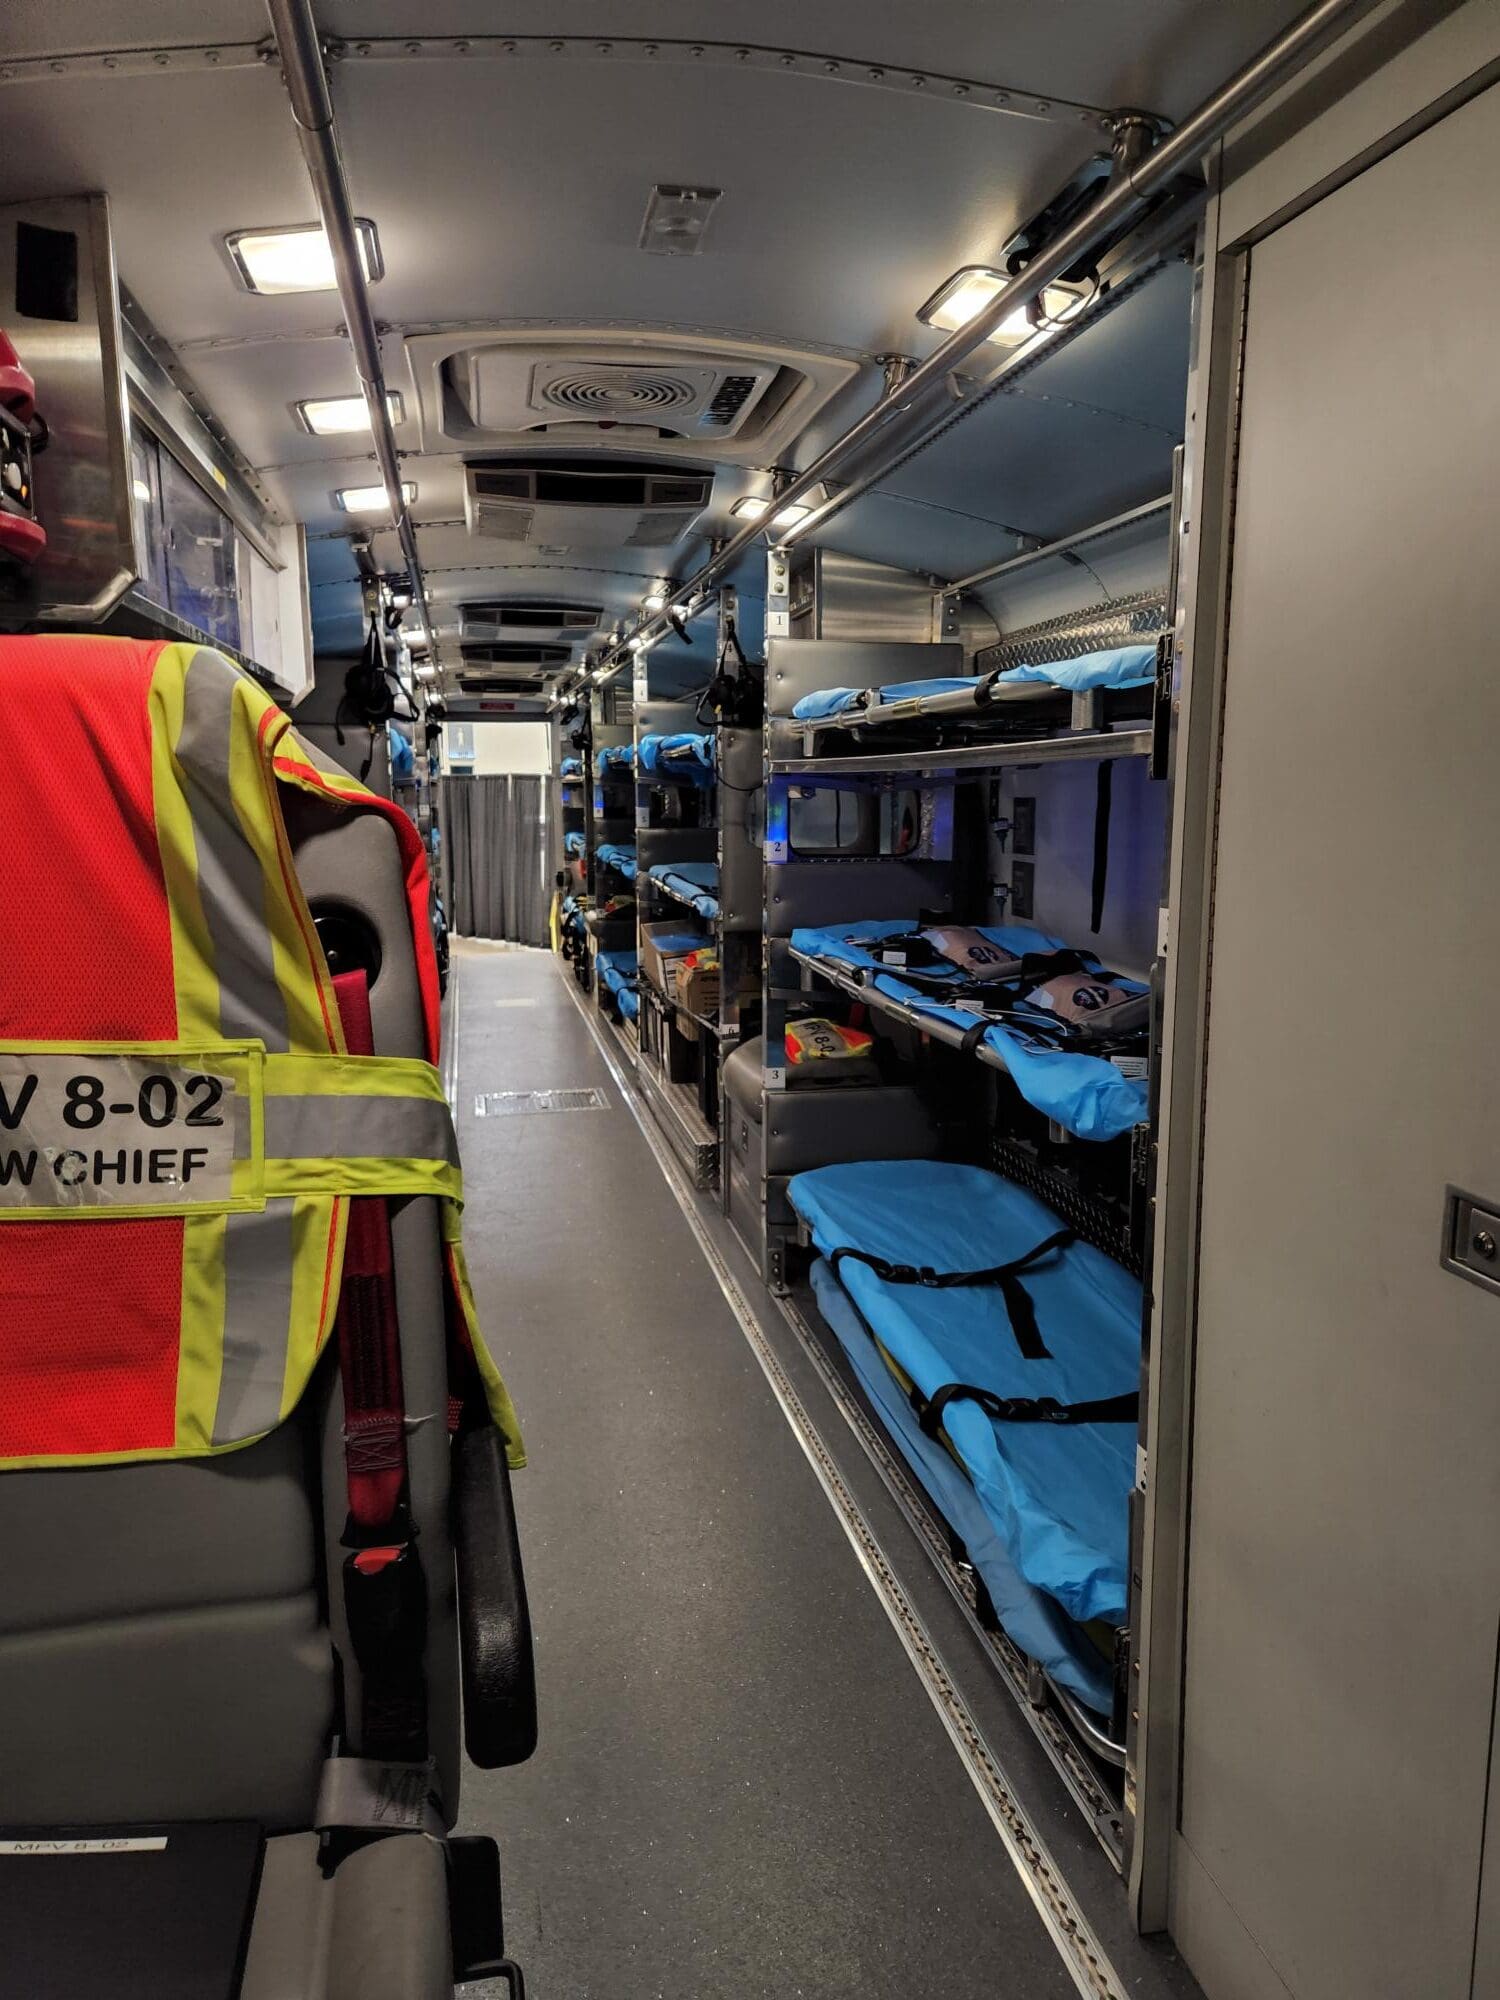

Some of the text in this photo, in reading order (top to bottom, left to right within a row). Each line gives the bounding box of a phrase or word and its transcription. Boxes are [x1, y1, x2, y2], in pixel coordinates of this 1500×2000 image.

[778, 616, 783, 625] 1
[774, 841, 781, 852] 2
[814, 1035, 836, 1057] 8-0
[772, 1069, 779, 1080] 3
[0, 1074, 224, 1129] V 8-02
[0, 1147, 209, 1186] W CHIEF
